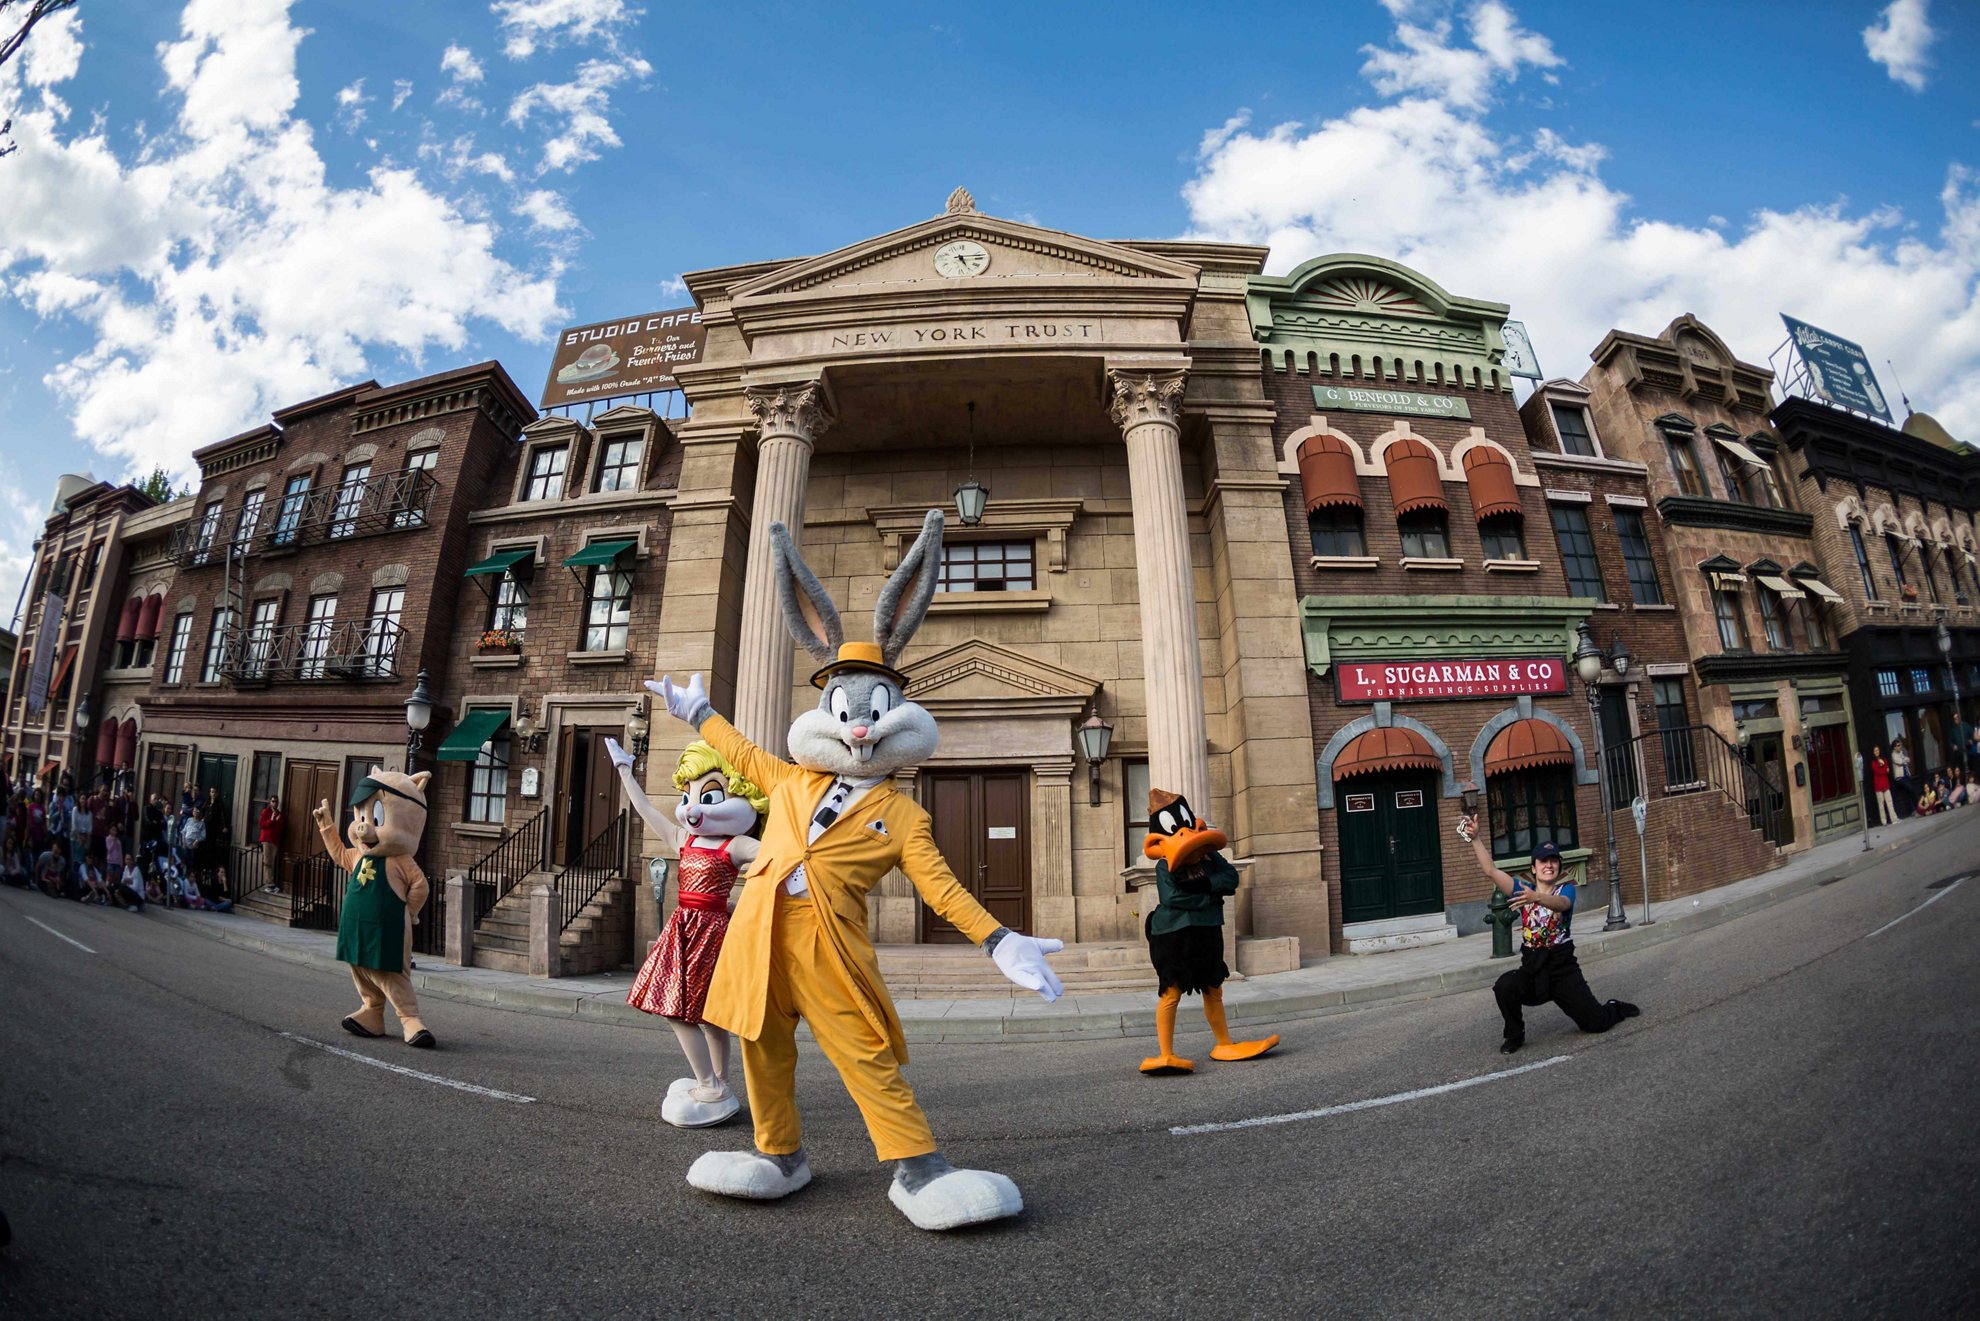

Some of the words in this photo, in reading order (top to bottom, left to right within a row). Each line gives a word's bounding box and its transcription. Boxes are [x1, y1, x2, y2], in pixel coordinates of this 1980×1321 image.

[565, 321, 641, 346] STUDIO
[645, 312, 702, 332] CAFE
[832, 331, 894, 348] NEW
[914, 326, 986, 342] YORK
[1005, 324, 1093, 338] TRUST
[633, 342, 677, 356] Burgers
[679, 340, 696, 350] and
[1687, 346, 1709, 360] 1892
[627, 353, 663, 368] French
[664, 349, 697, 363] Fries!
[566, 387, 584, 396] Made
[586, 383, 600, 393] with
[601, 381, 618, 391] 100%
[620, 379, 641, 388] Grade
[1326, 389, 1341, 400] G.
[1348, 390, 1411, 405] BENFOLD
[1416, 395, 1429, 407] &
[1355, 402, 1392, 410] PURVEYORS
[1356, 668, 1377, 685] L.
[1385, 664, 1500, 684] SUGARMAN
[1508, 664, 1521, 680] &
[1526, 663, 1553, 680] CO
